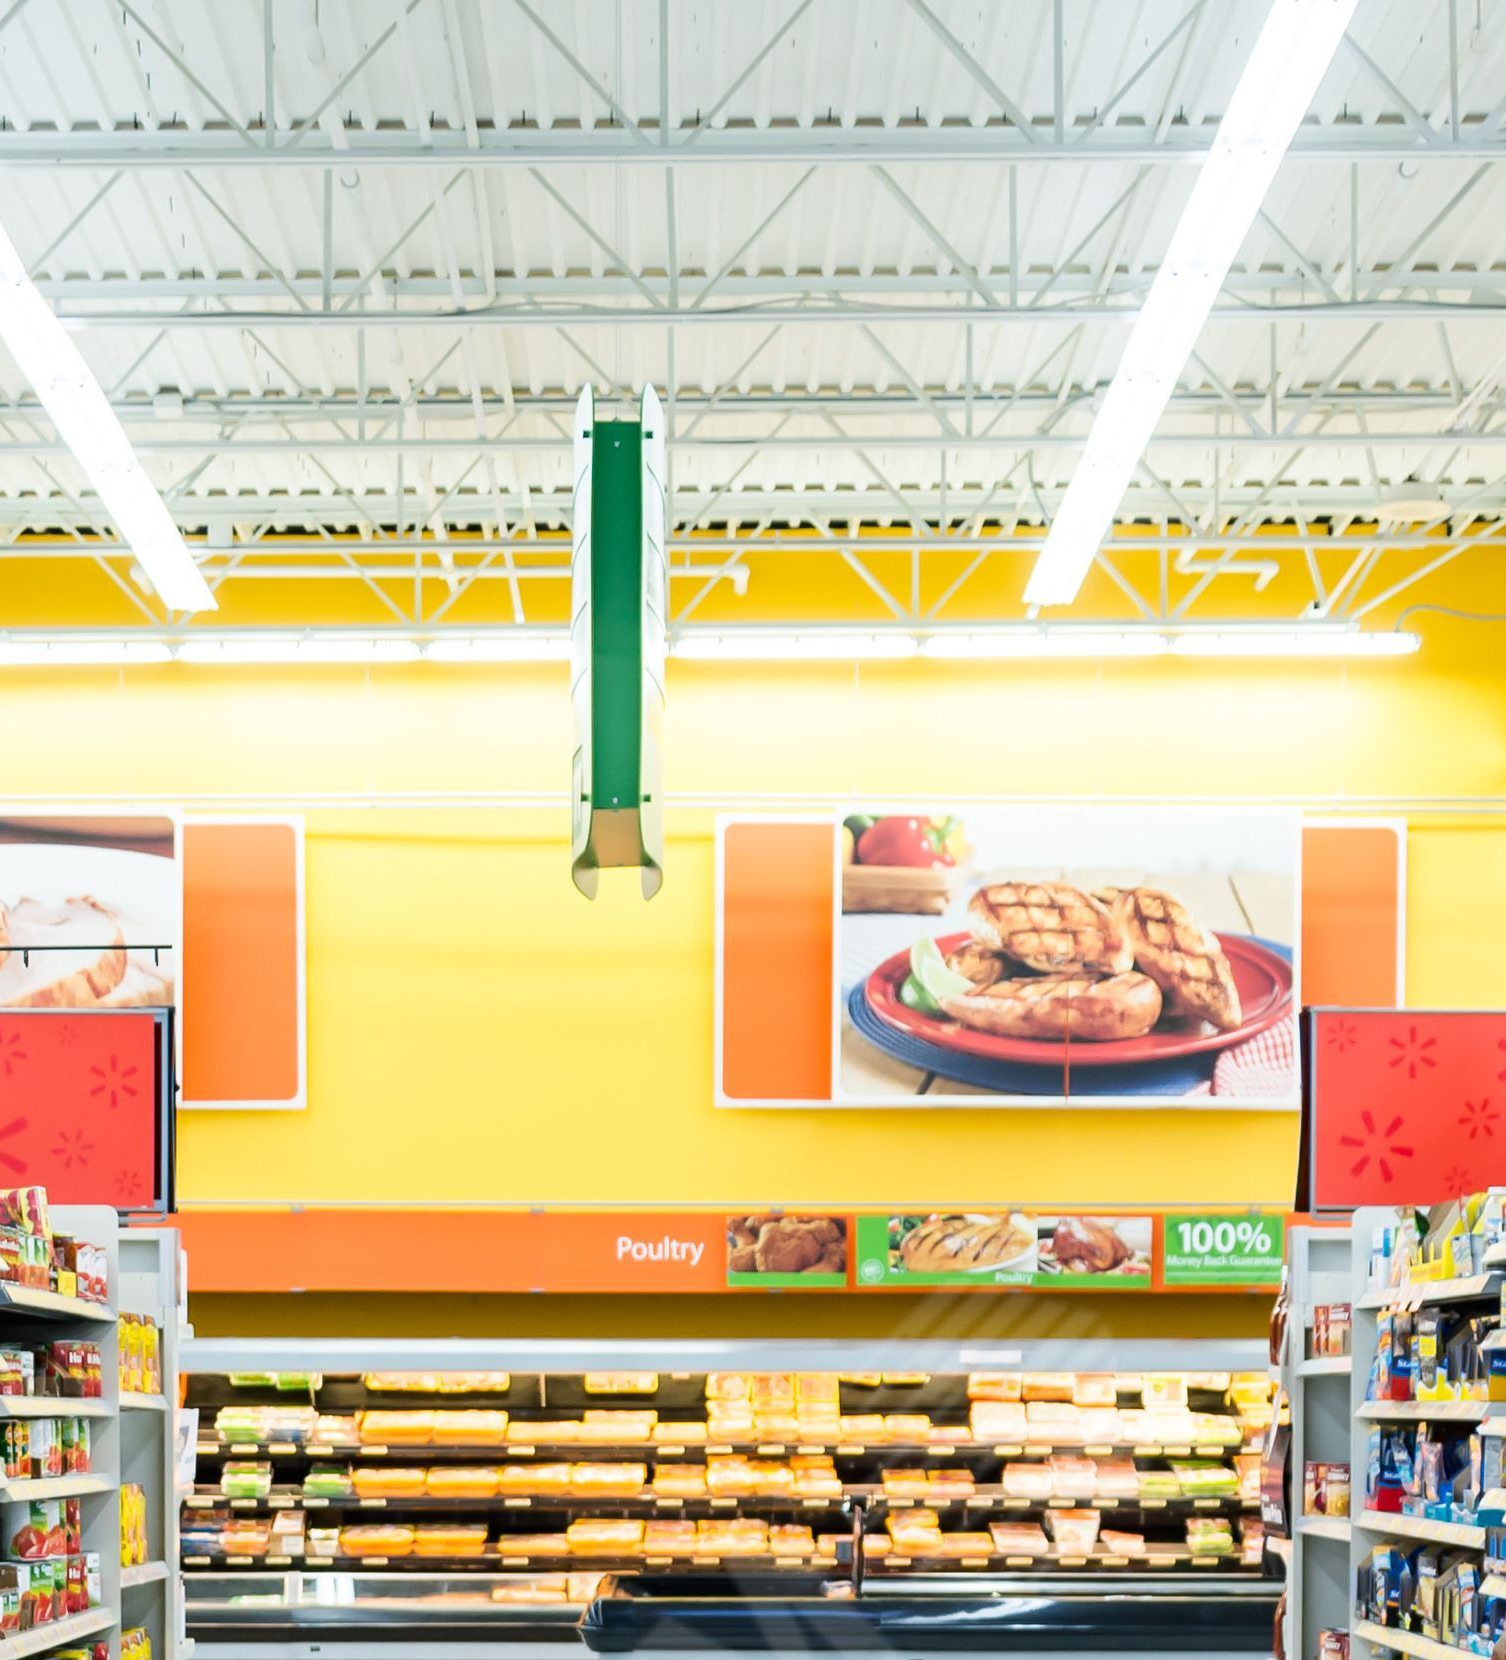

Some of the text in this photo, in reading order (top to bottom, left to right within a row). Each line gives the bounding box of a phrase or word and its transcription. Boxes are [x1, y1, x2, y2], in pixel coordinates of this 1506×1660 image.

[1178, 1221, 1271, 1254] 100%
[617, 1236, 704, 1266] Poultry
[1167, 1255, 1282, 1267] Money Back Guarantee
[995, 1272, 1033, 1283] Poultry
